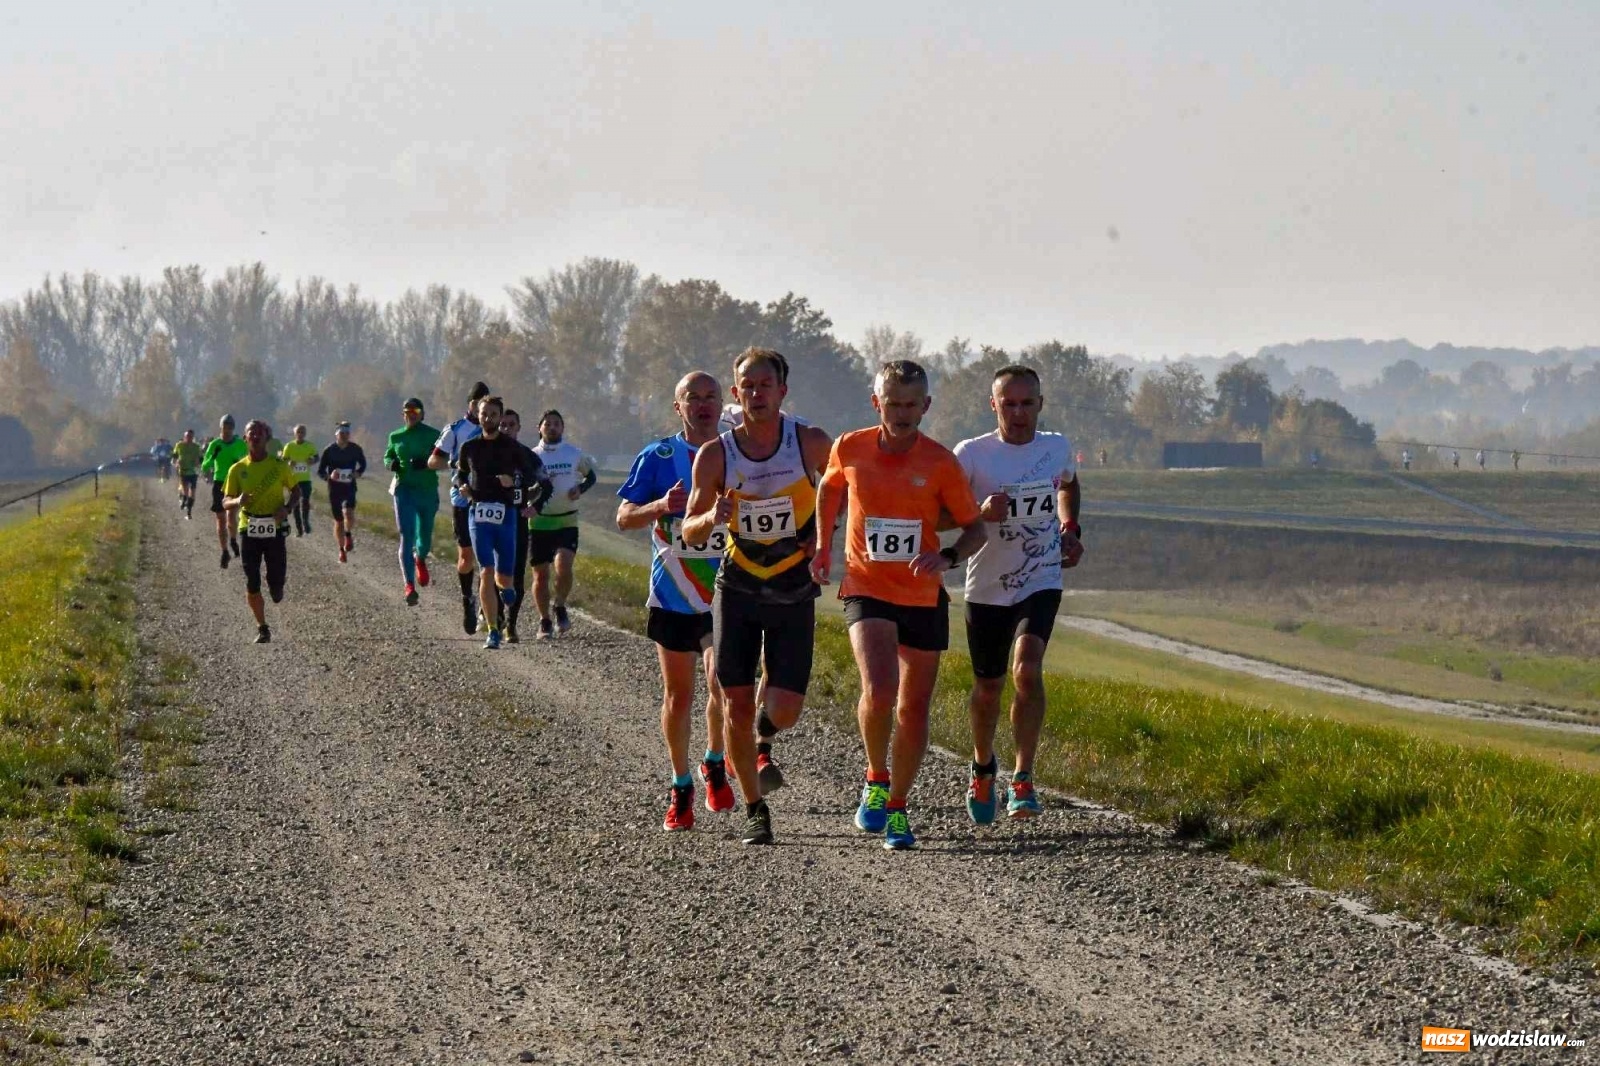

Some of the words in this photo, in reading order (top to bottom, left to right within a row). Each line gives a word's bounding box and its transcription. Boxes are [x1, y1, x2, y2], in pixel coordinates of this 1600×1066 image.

[477, 508, 503, 520] 103
[1007, 494, 1054, 517] 174
[249, 524, 275, 534] 206
[741, 511, 792, 533] 197
[868, 533, 915, 555] 181
